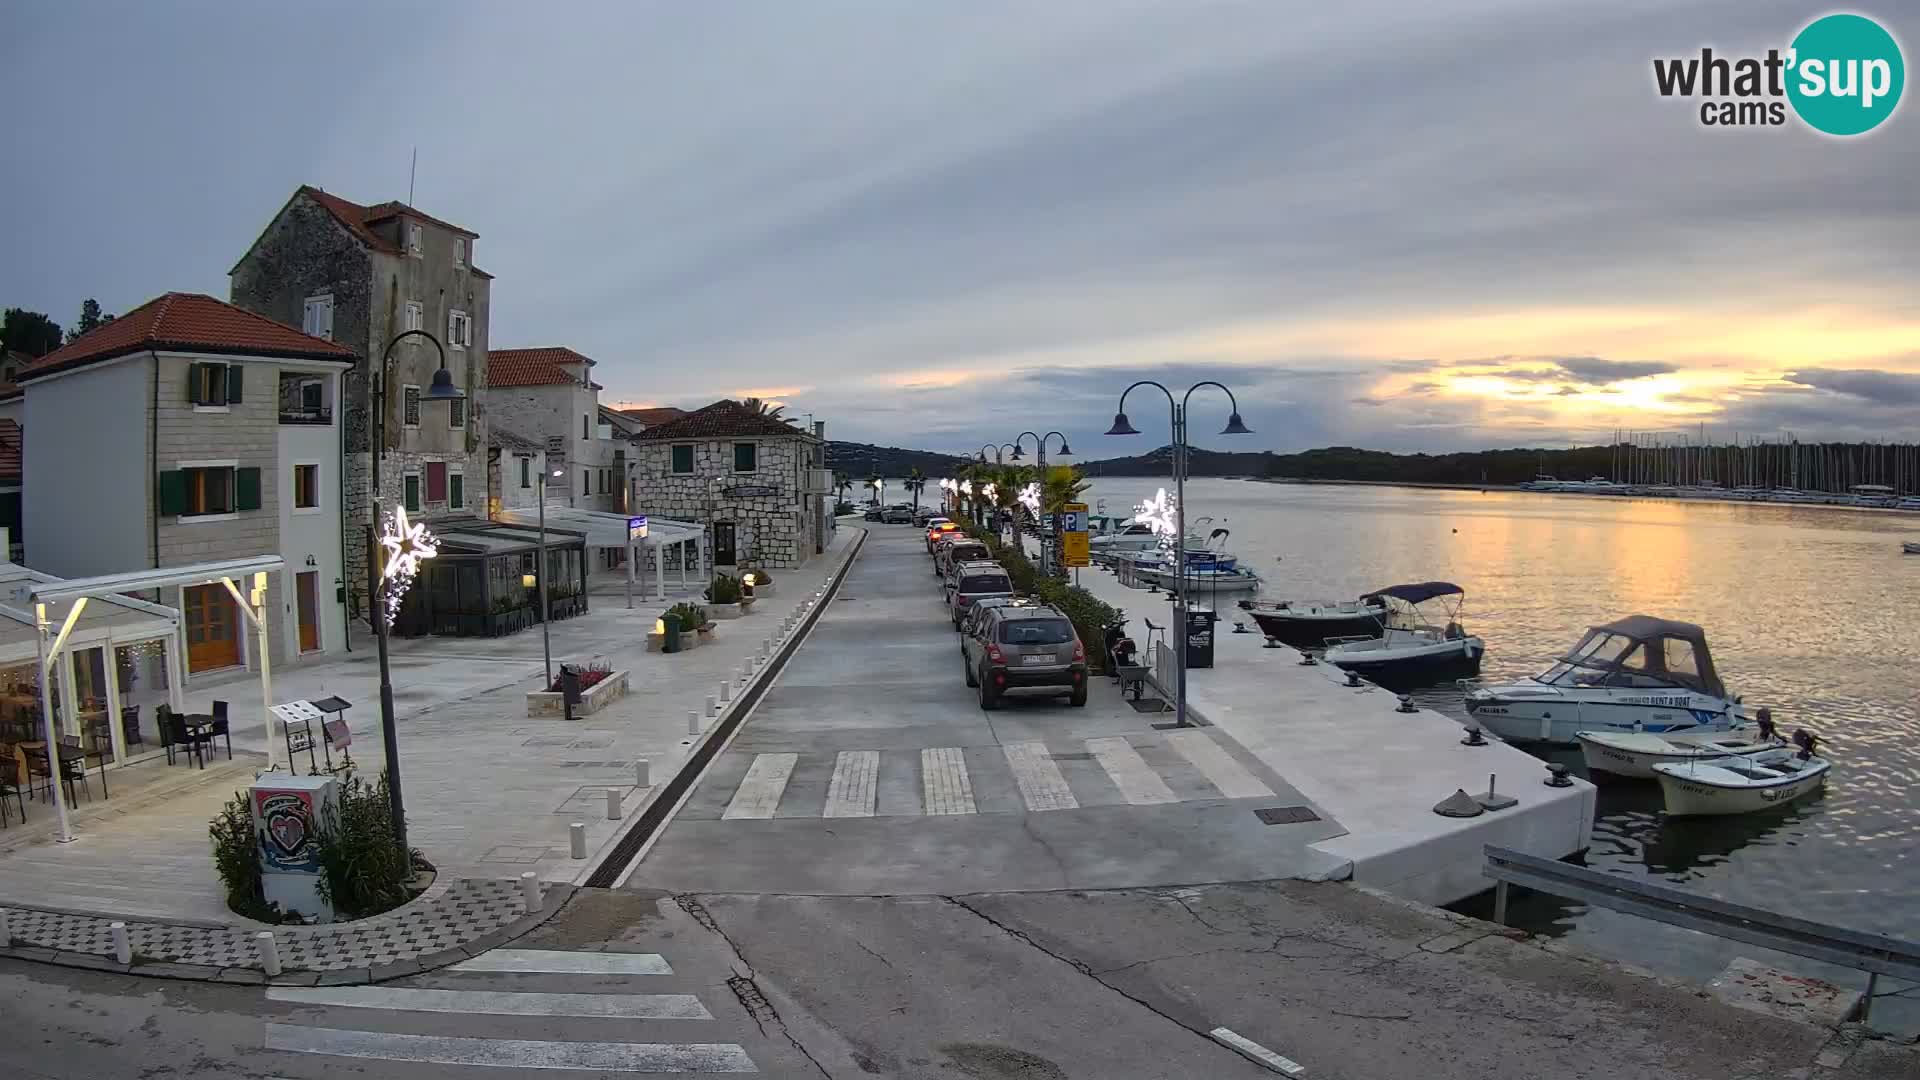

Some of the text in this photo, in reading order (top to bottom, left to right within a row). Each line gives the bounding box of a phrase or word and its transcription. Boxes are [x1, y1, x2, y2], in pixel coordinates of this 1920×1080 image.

[1066, 514, 1076, 529] P
[1650, 696, 1668, 705] RENT
[1674, 696, 1691, 707] BOAT
